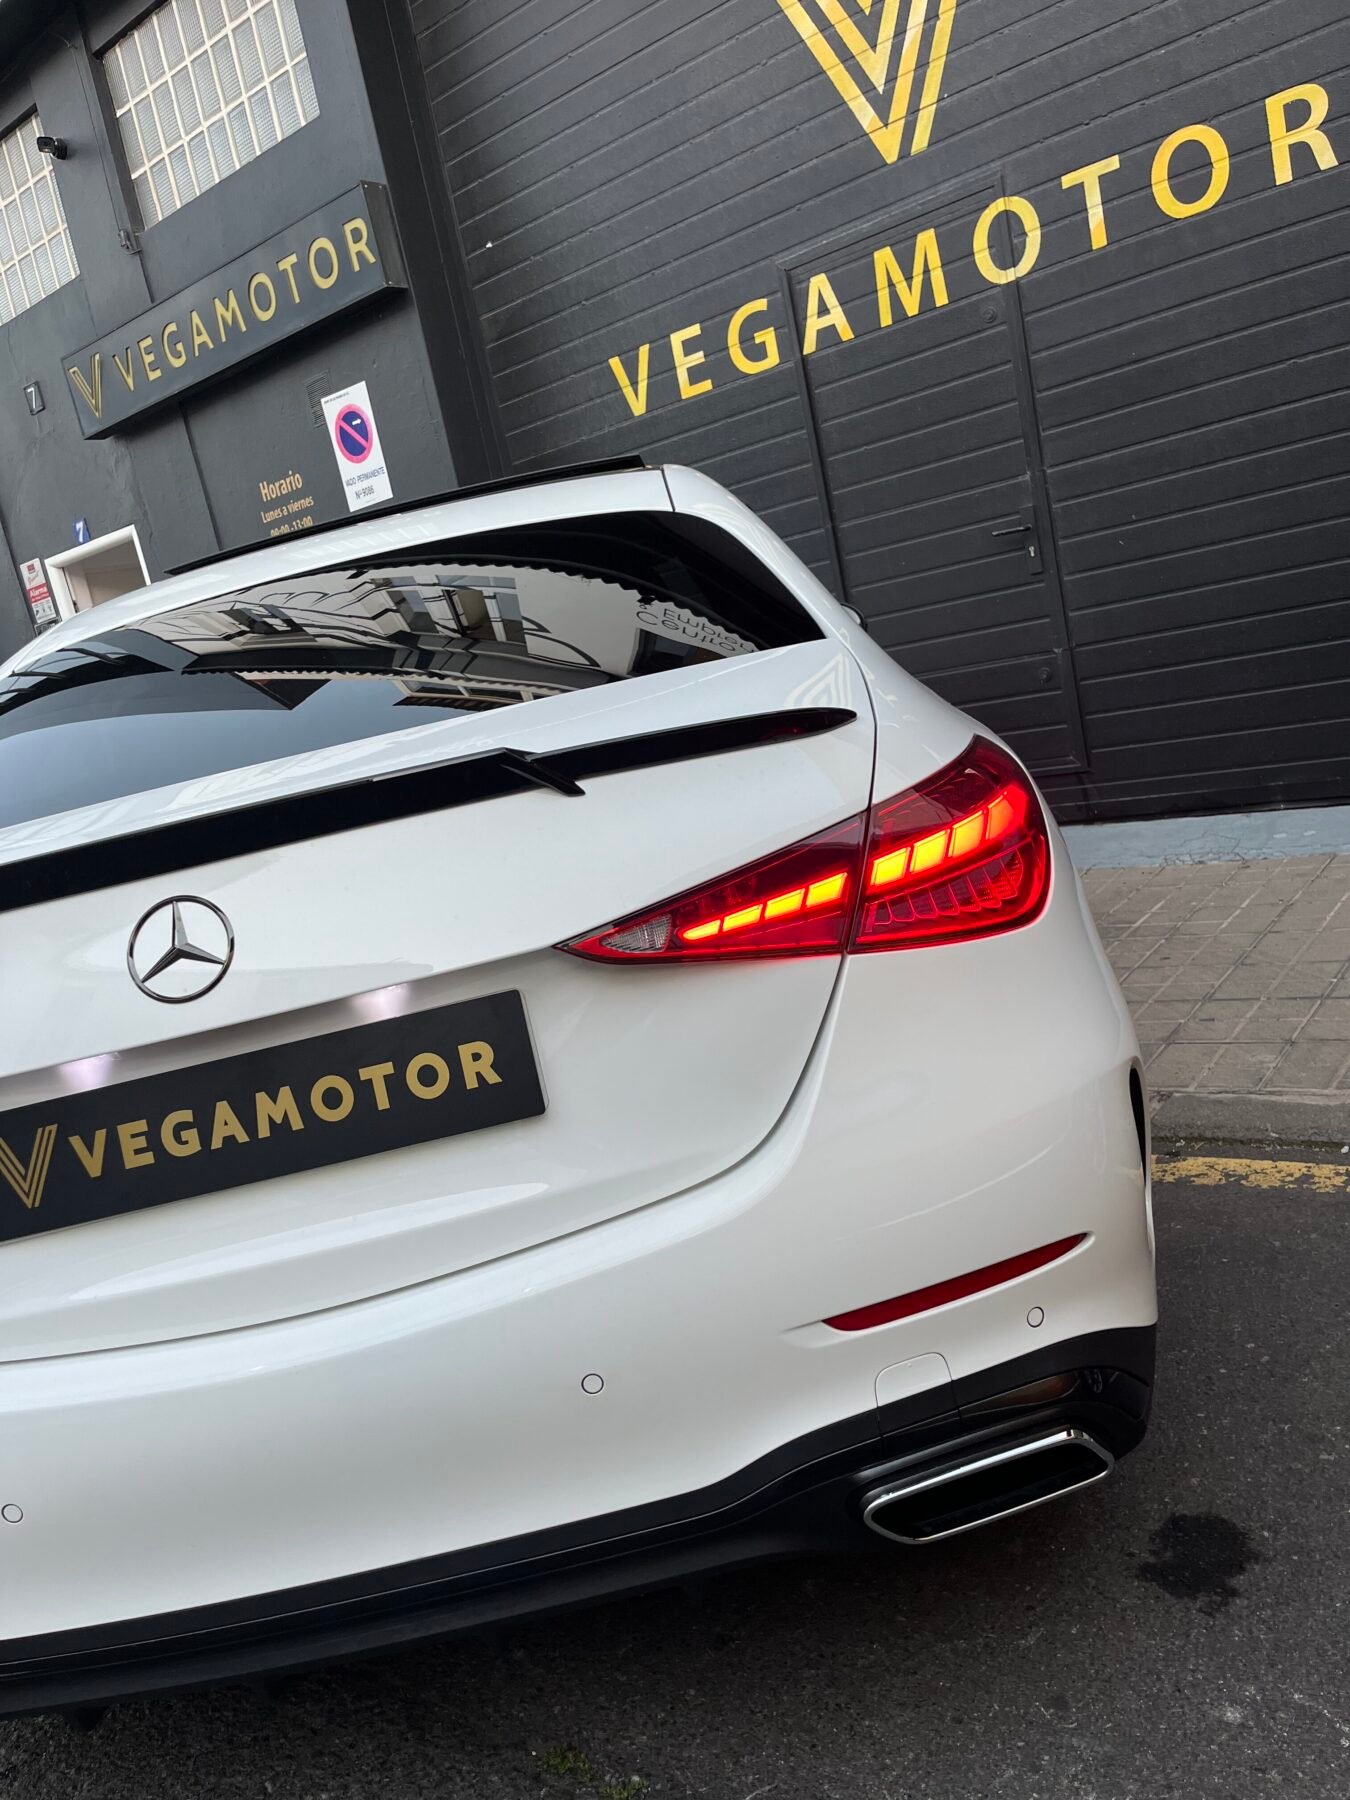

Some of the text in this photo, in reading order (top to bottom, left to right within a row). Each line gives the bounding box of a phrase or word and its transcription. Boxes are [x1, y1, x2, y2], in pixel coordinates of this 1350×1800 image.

[609, 83, 1338, 417] VEGAMOTOR
[112, 217, 376, 392] VEGAMOTOR
[27, 387, 36, 409] 7
[259, 470, 303, 502] Horario
[357, 467, 385, 483] PERMANENTE
[261, 507, 283, 523] Lunes
[288, 495, 315, 513] viernes
[76, 521, 84, 543] 7
[69, 1040, 503, 1178] VEGAMOTOR
